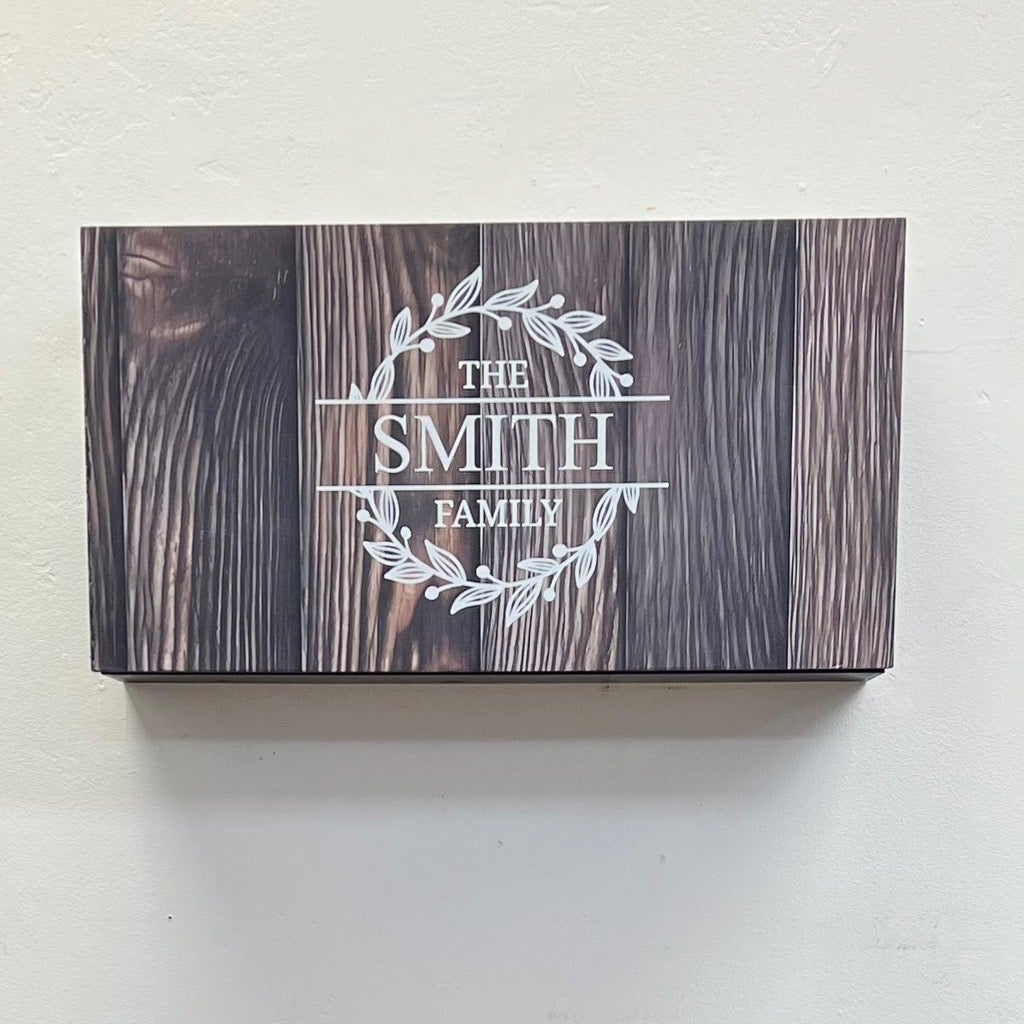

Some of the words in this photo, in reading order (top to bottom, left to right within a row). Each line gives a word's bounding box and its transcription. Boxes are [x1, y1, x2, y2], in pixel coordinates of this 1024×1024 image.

[458, 360, 529, 390] THE
[374, 412, 614, 474] SMITH
[434, 499, 562, 528] FAMILY
